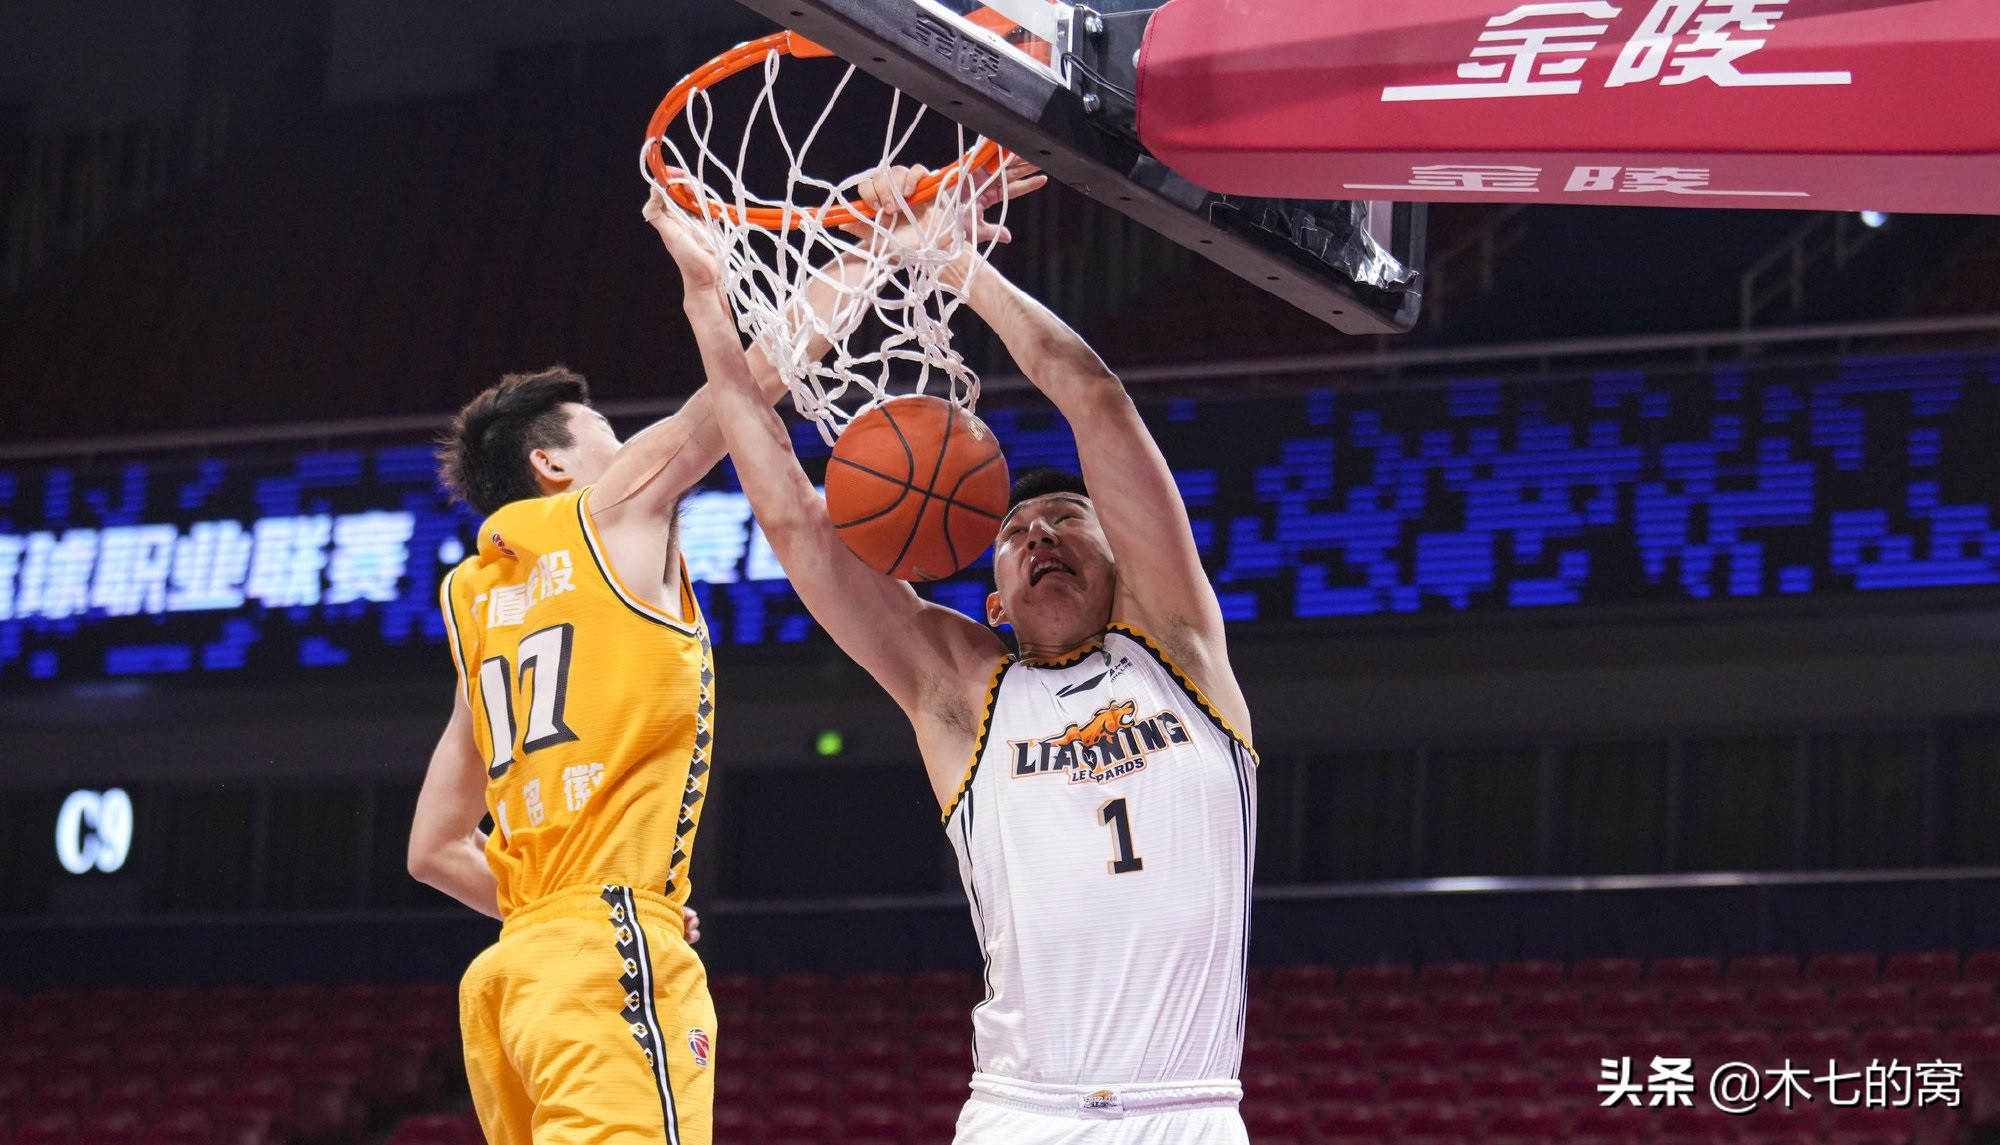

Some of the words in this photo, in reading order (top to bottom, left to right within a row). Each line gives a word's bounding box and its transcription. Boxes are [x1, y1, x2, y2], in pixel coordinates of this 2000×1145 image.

[1381, 0, 1852, 102] 金陵
[1342, 165, 1811, 197] 金陵
[479, 622, 580, 780] 17
[55, 787, 134, 875] C9
[1096, 797, 1143, 875] 1
